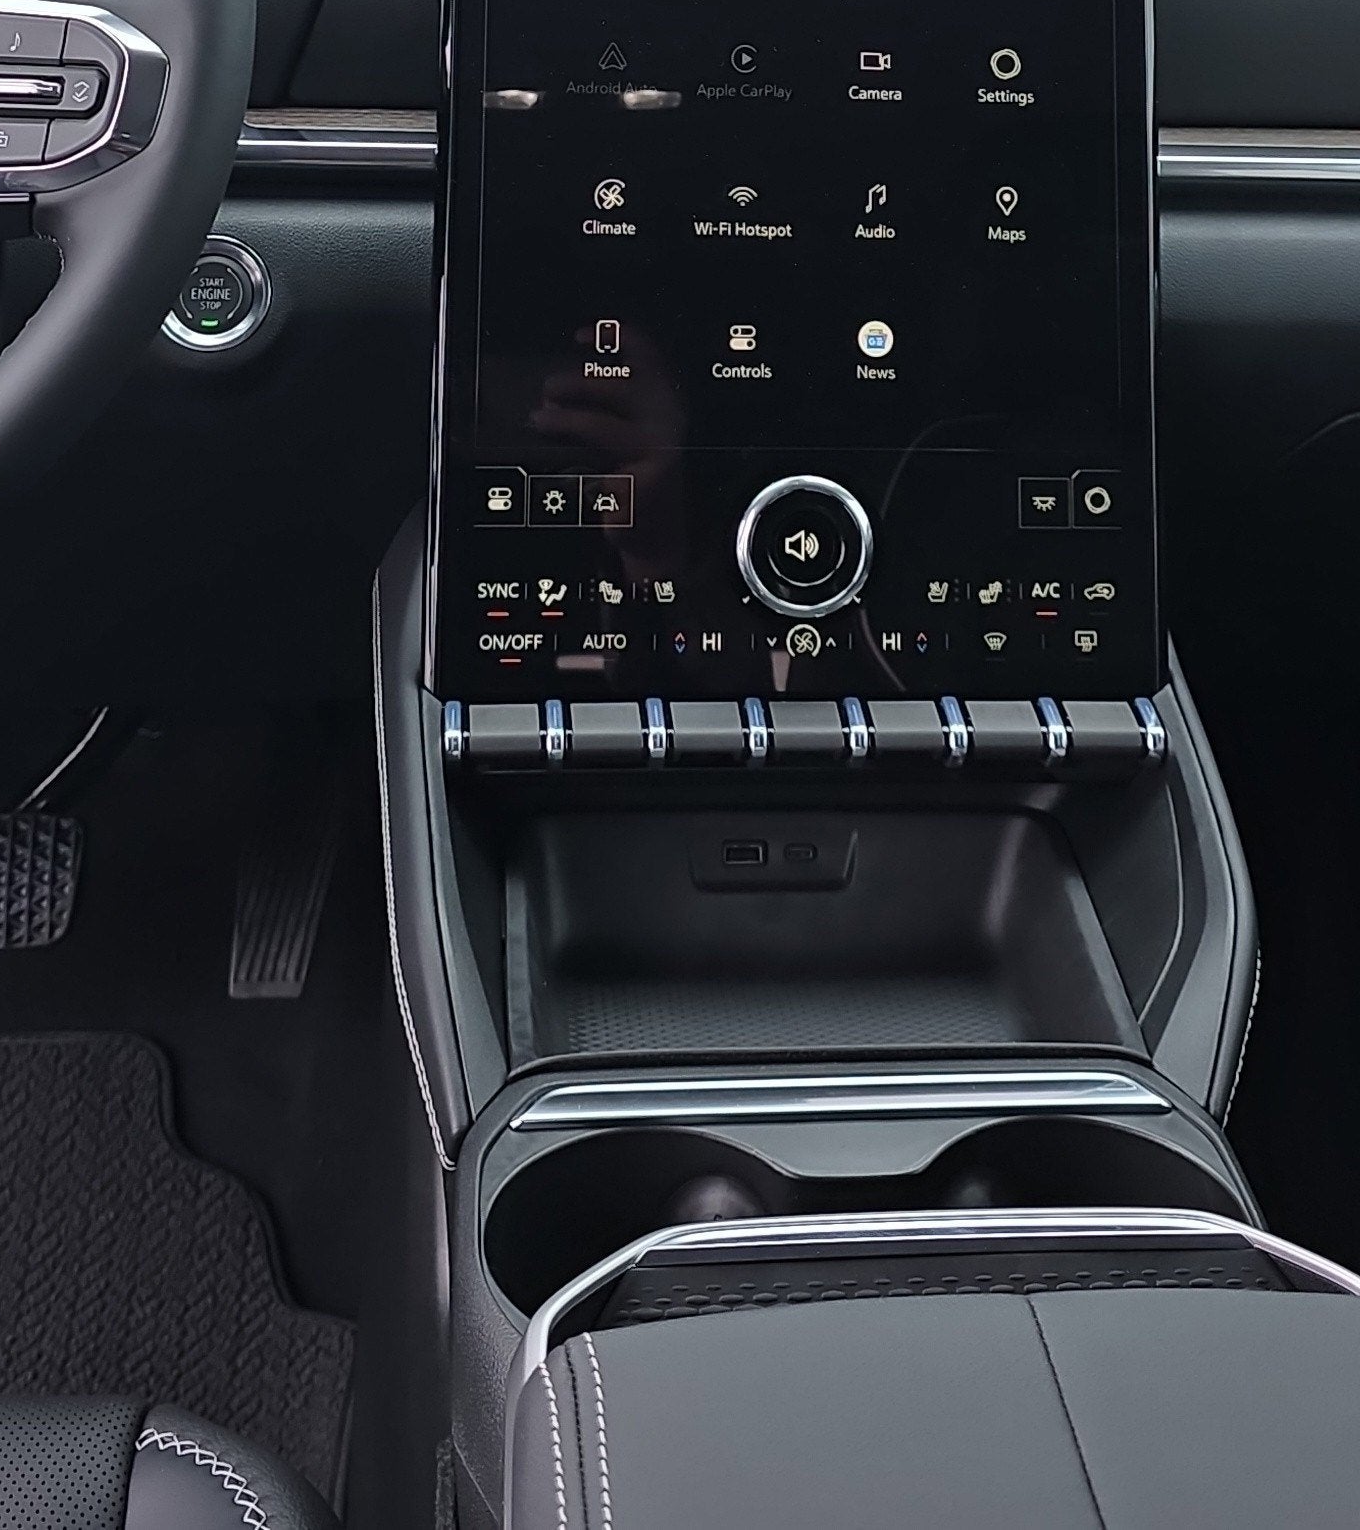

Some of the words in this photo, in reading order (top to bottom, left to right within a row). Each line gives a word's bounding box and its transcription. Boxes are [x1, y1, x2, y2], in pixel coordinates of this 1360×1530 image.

[566, 81, 621, 95] Android
[696, 84, 736, 99] Apple
[740, 84, 792, 101] CarPlay
[848, 85, 902, 101] Camera
[977, 88, 1034, 106] Settings
[583, 220, 636, 235] Climate
[694, 222, 732, 236] Wi-Fi
[735, 222, 792, 240] Hotspot
[855, 223, 895, 239] Audio
[988, 226, 1026, 243] Maps
[199, 278, 224, 287] START
[190, 288, 231, 300] ENGINE
[200, 301, 222, 310] STOP
[584, 362, 630, 378] Phone
[712, 362, 772, 379] Controls
[856, 365, 896, 380] News
[478, 582, 519, 598] SYNC
[1031, 582, 1060, 598] A/C
[479, 634, 543, 650] ON/OFF
[583, 634, 627, 650] AUTO
[702, 632, 722, 651] HI
[881, 632, 901, 651] HI
